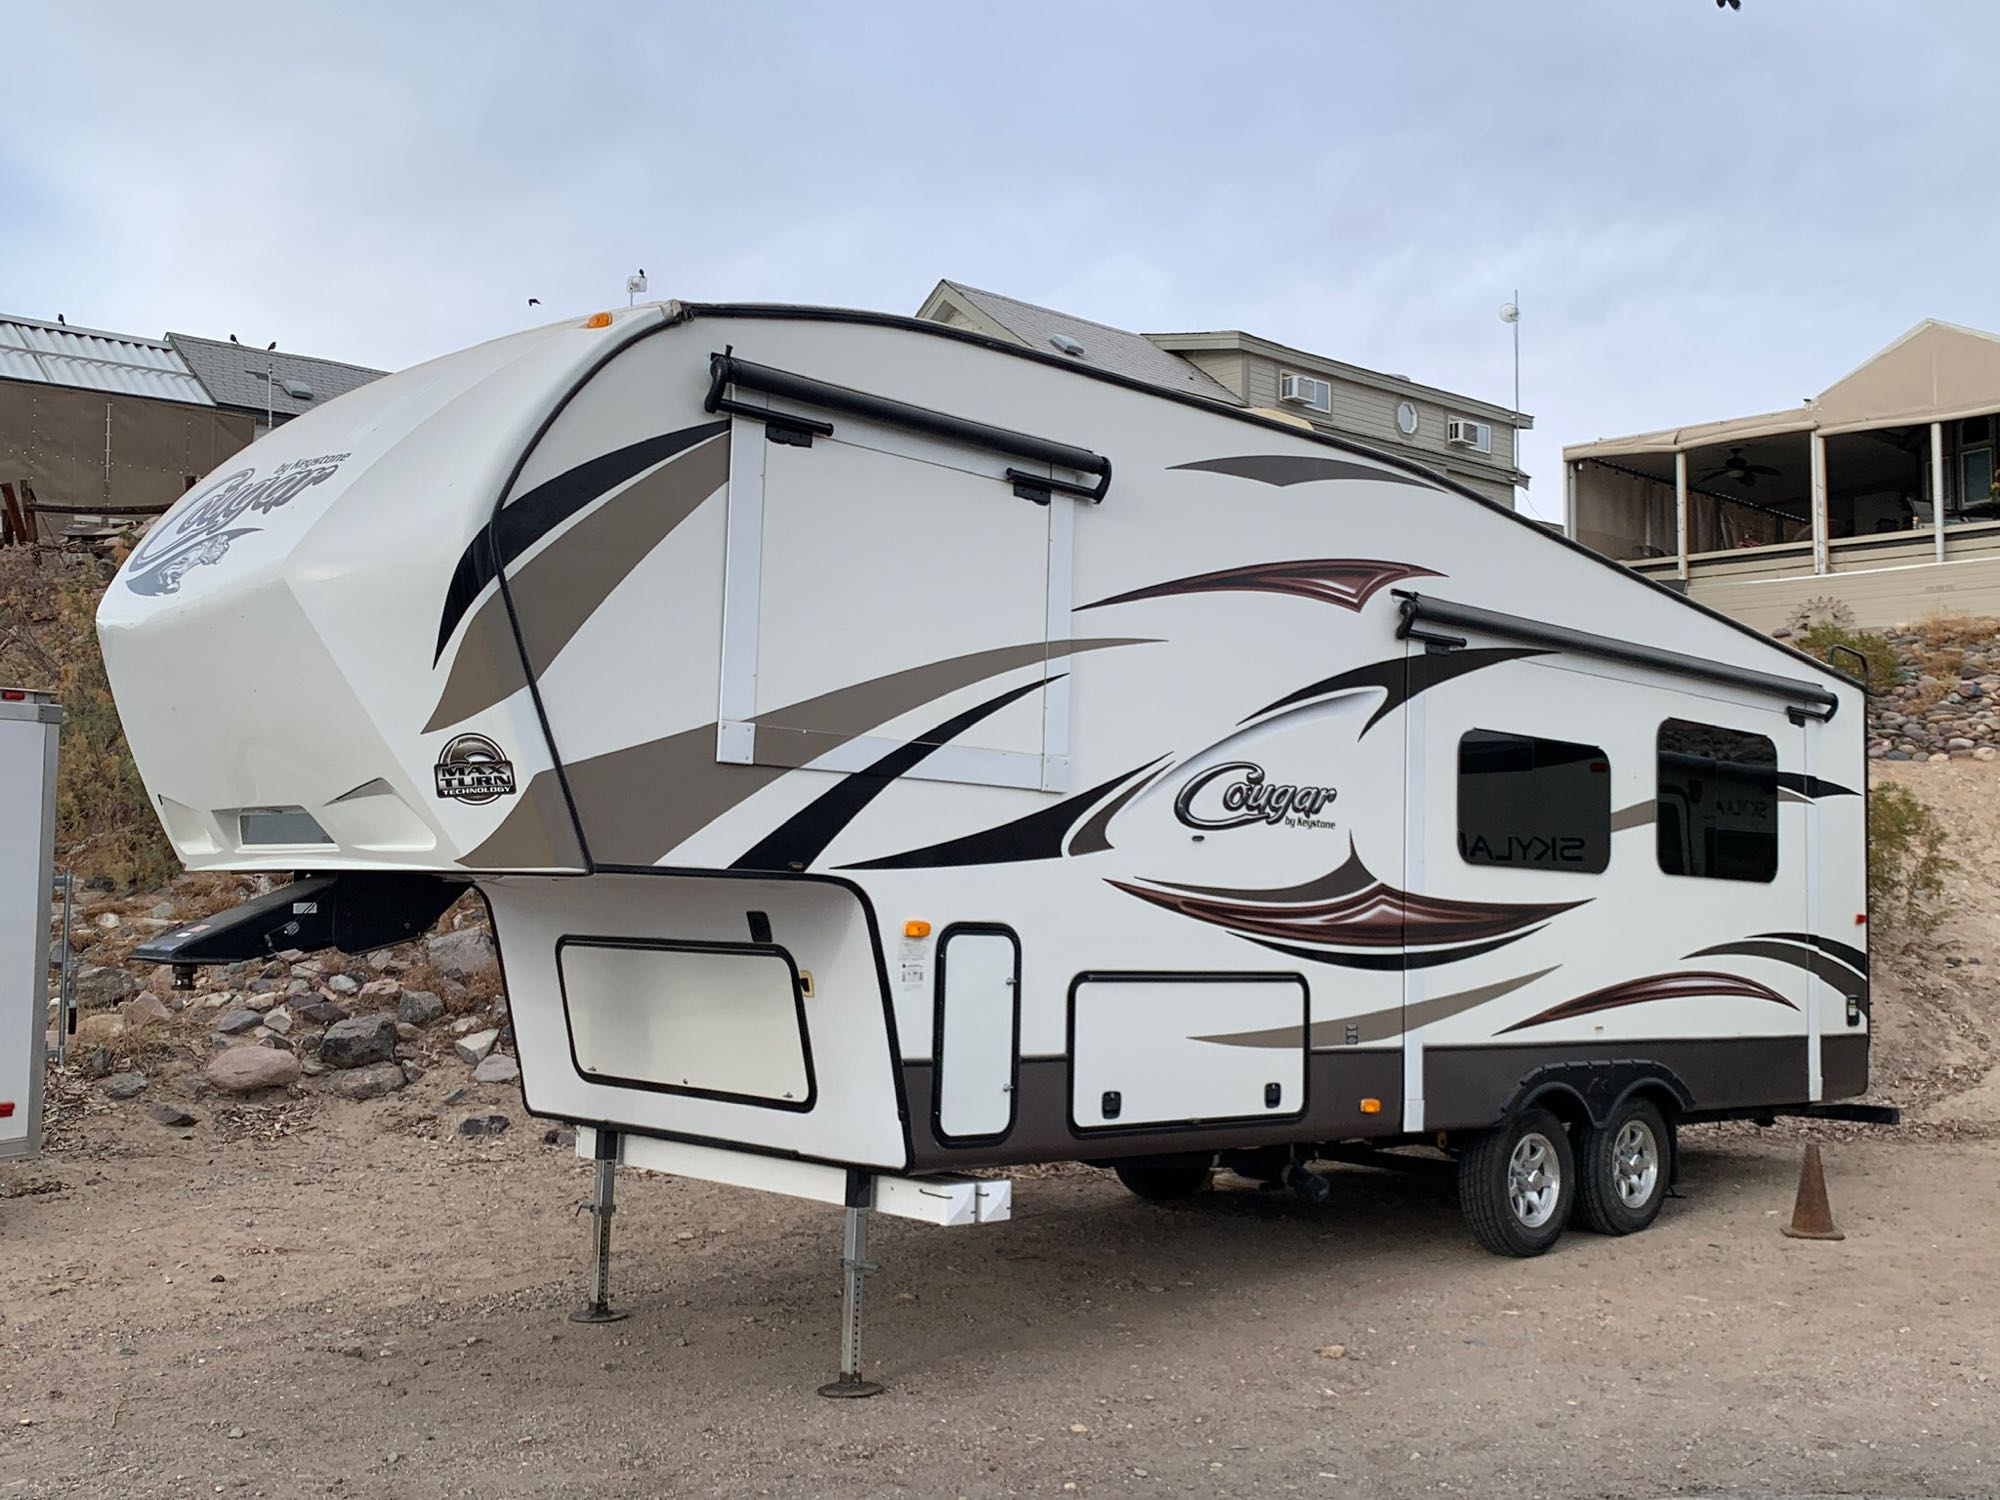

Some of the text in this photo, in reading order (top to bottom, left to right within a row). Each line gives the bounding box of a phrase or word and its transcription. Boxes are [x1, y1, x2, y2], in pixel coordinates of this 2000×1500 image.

[273, 453, 352, 475] by Keystone
[128, 464, 339, 573] Cougar
[441, 765, 507, 777] MAX
[440, 775, 511, 787] TURN
[443, 786, 511, 795] TECHNOLOGY
[1173, 760, 1337, 831] Cougar
[1284, 815, 1336, 830] by Keystone
